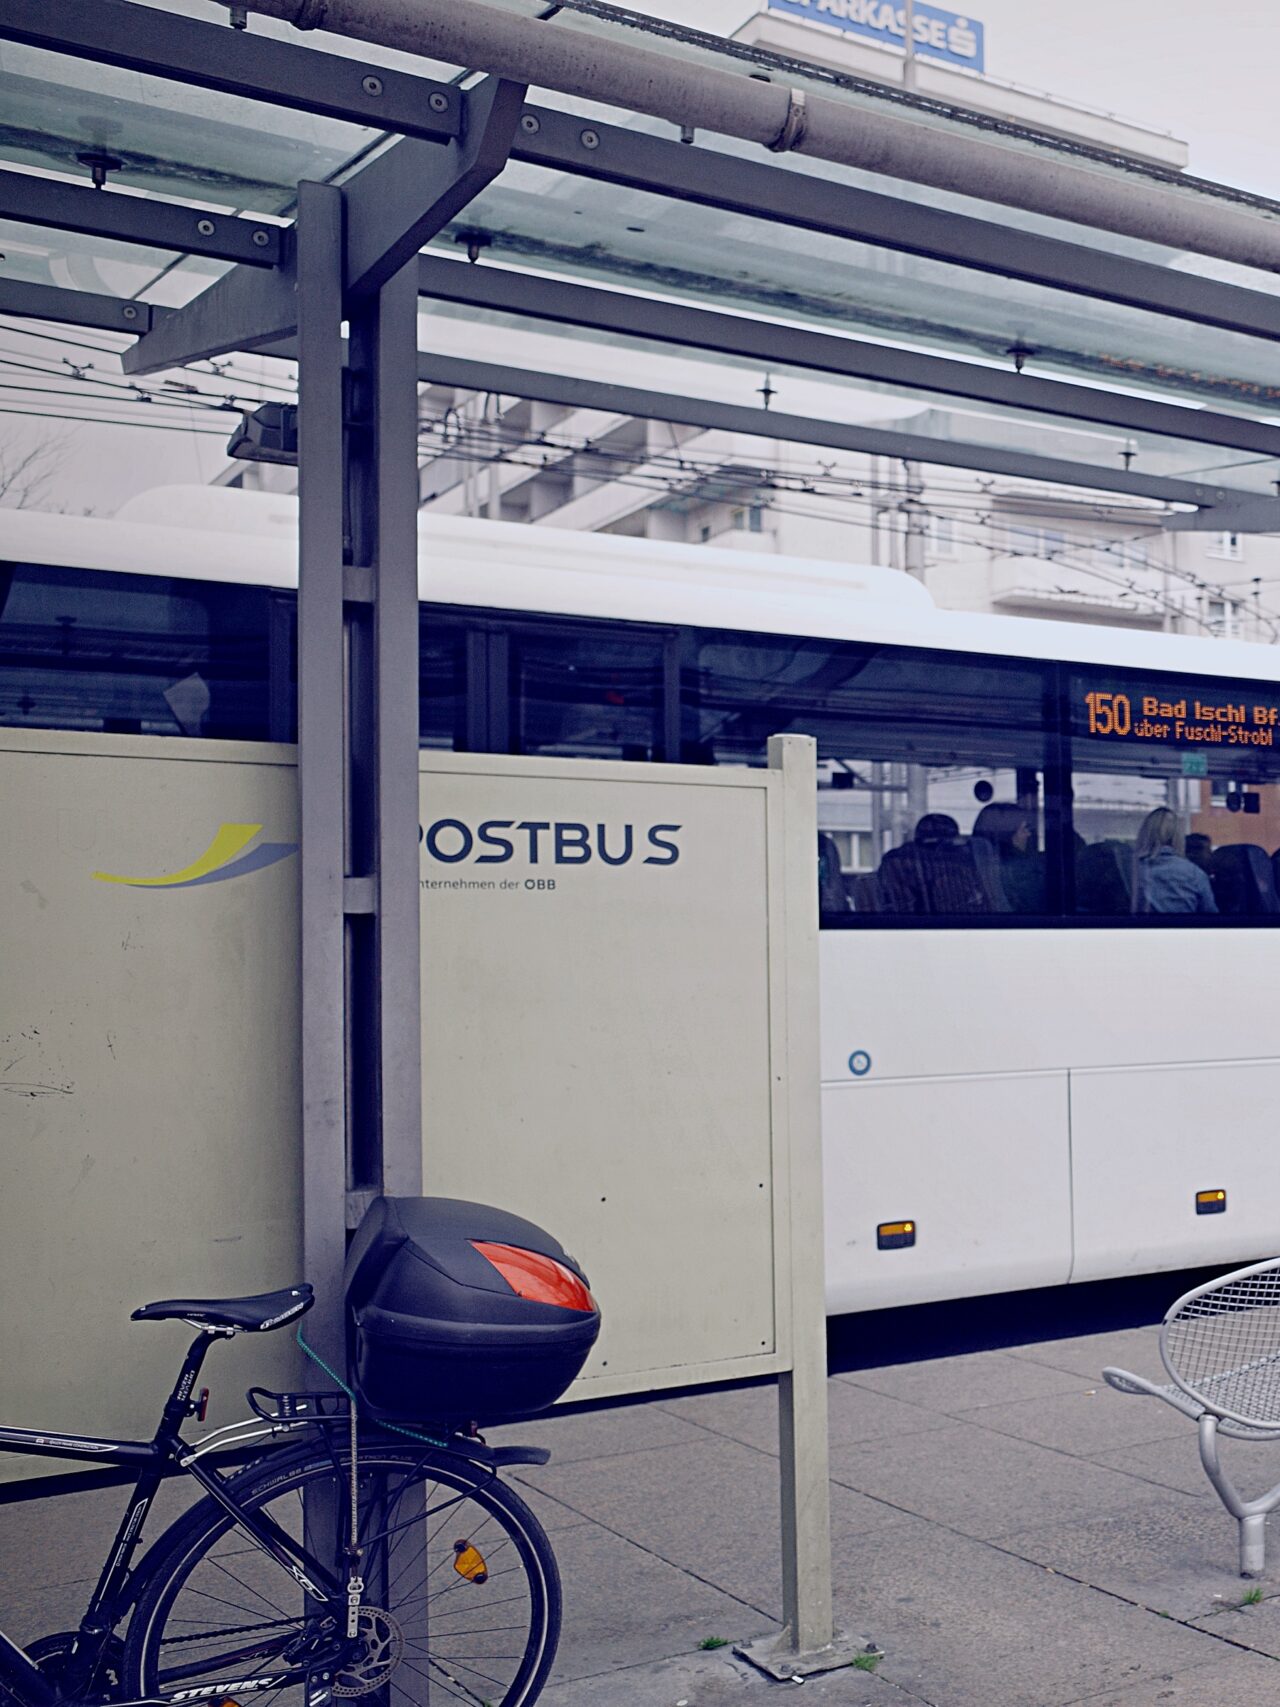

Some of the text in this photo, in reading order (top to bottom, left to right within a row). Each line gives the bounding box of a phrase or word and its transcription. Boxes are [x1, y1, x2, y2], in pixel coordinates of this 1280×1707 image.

[784, 0, 947, 49] ARKASSE
[1085, 692, 1131, 736] 150
[1142, 696, 1186, 719] Bad
[1195, 700, 1246, 723] Ischl
[1134, 718, 1273, 746] über Fuschl-Strobl
[419, 818, 682, 866] OSTBUS
[419, 878, 495, 890] nternehmen
[499, 878, 520, 890] der
[252, 1468, 302, 1496] SCHWALBE
[170, 1678, 273, 1702] STEVENS
